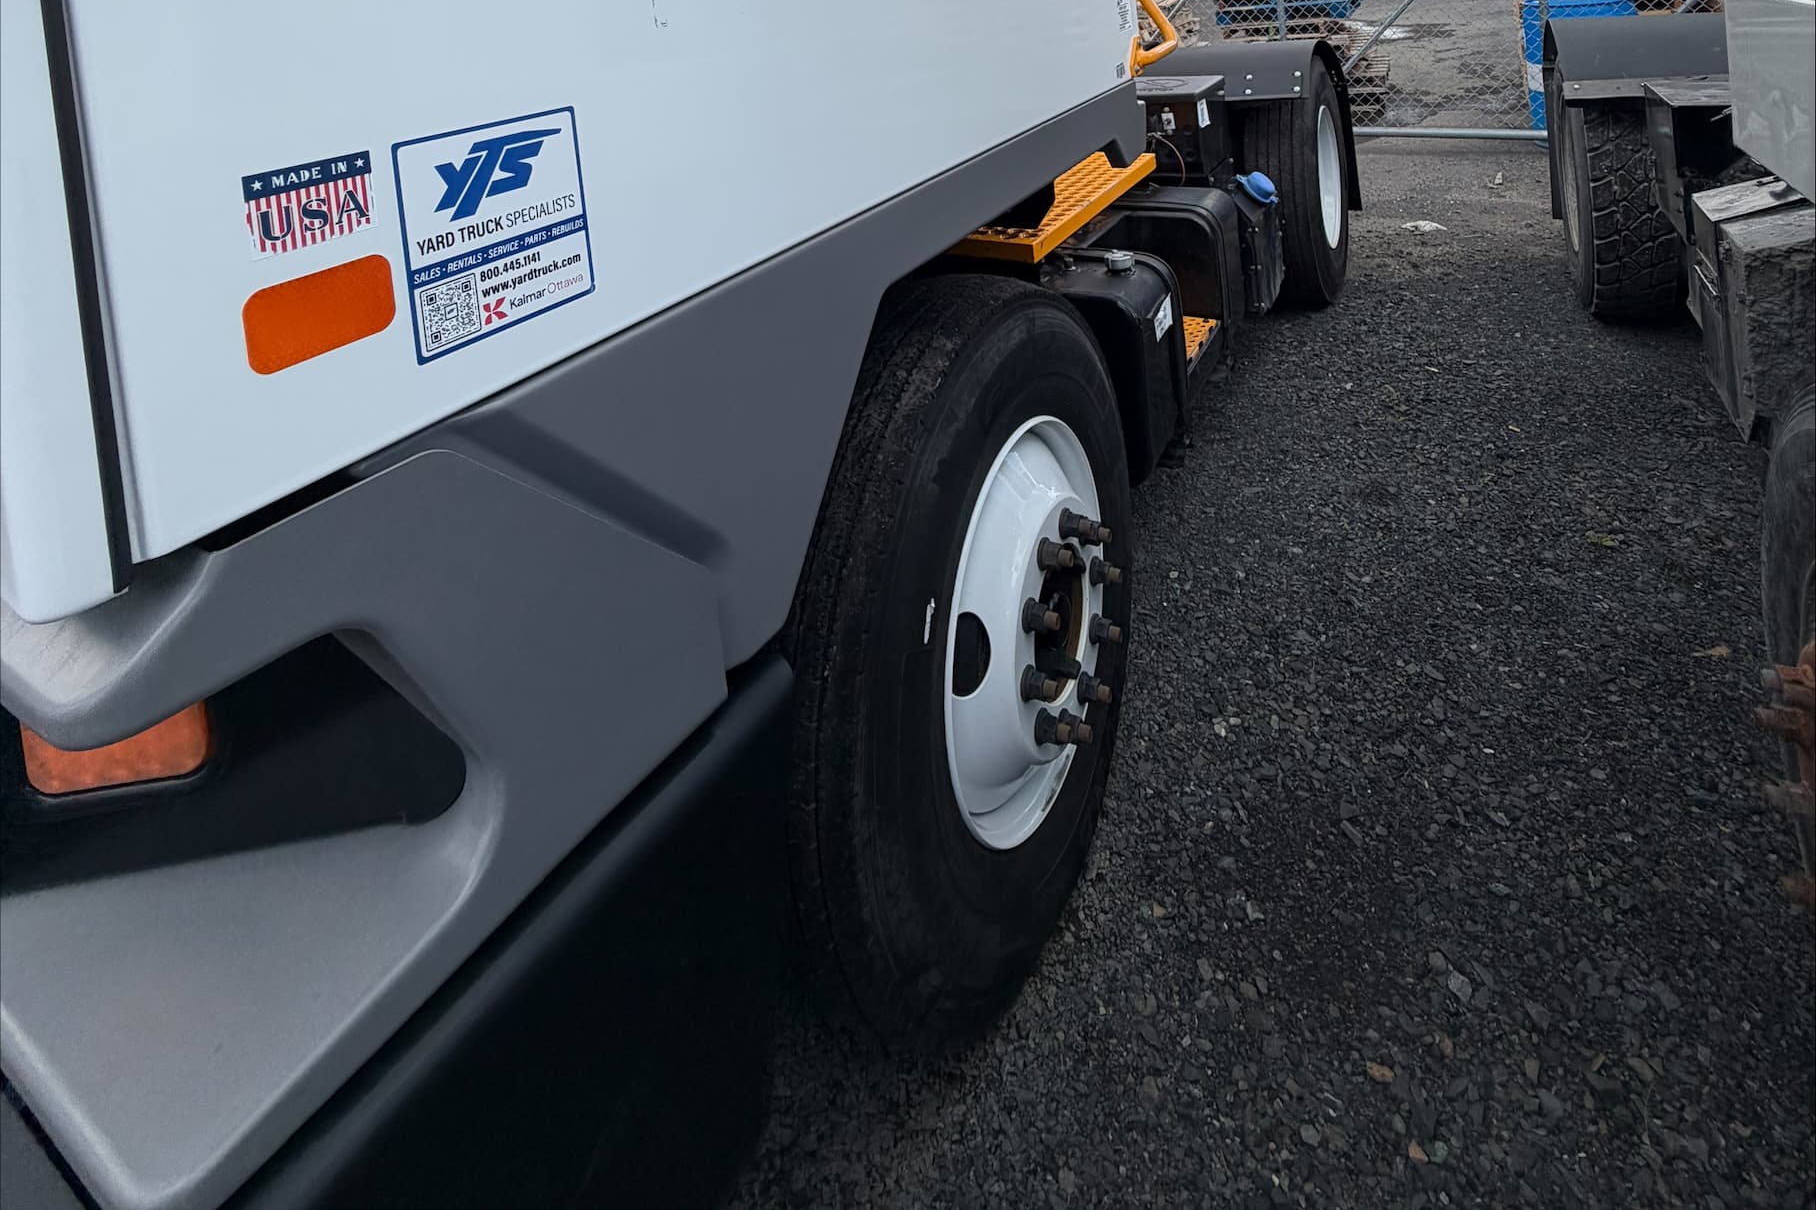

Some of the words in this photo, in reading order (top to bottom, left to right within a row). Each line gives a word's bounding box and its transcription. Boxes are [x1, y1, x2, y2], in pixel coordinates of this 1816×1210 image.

[271, 167, 322, 189] MADE
[331, 160, 348, 175] IN
[434, 128, 562, 223] YTS
[258, 189, 370, 241] USA
[416, 231, 455, 256] YARD
[458, 216, 504, 243] TRUCK
[506, 193, 576, 228] SPECIALISTS
[413, 266, 441, 284] SALES
[447, 253, 482, 273] RENTALS
[488, 242, 519, 258] SERVICE
[524, 231, 547, 247] PARTS
[552, 219, 584, 237] REBUILDS
[480, 251, 541, 282] 800.445.1141
[481, 253, 582, 298] www.yardtruck.com
[509, 288, 546, 310] Kalmar
[547, 274, 584, 294] Ottawa
